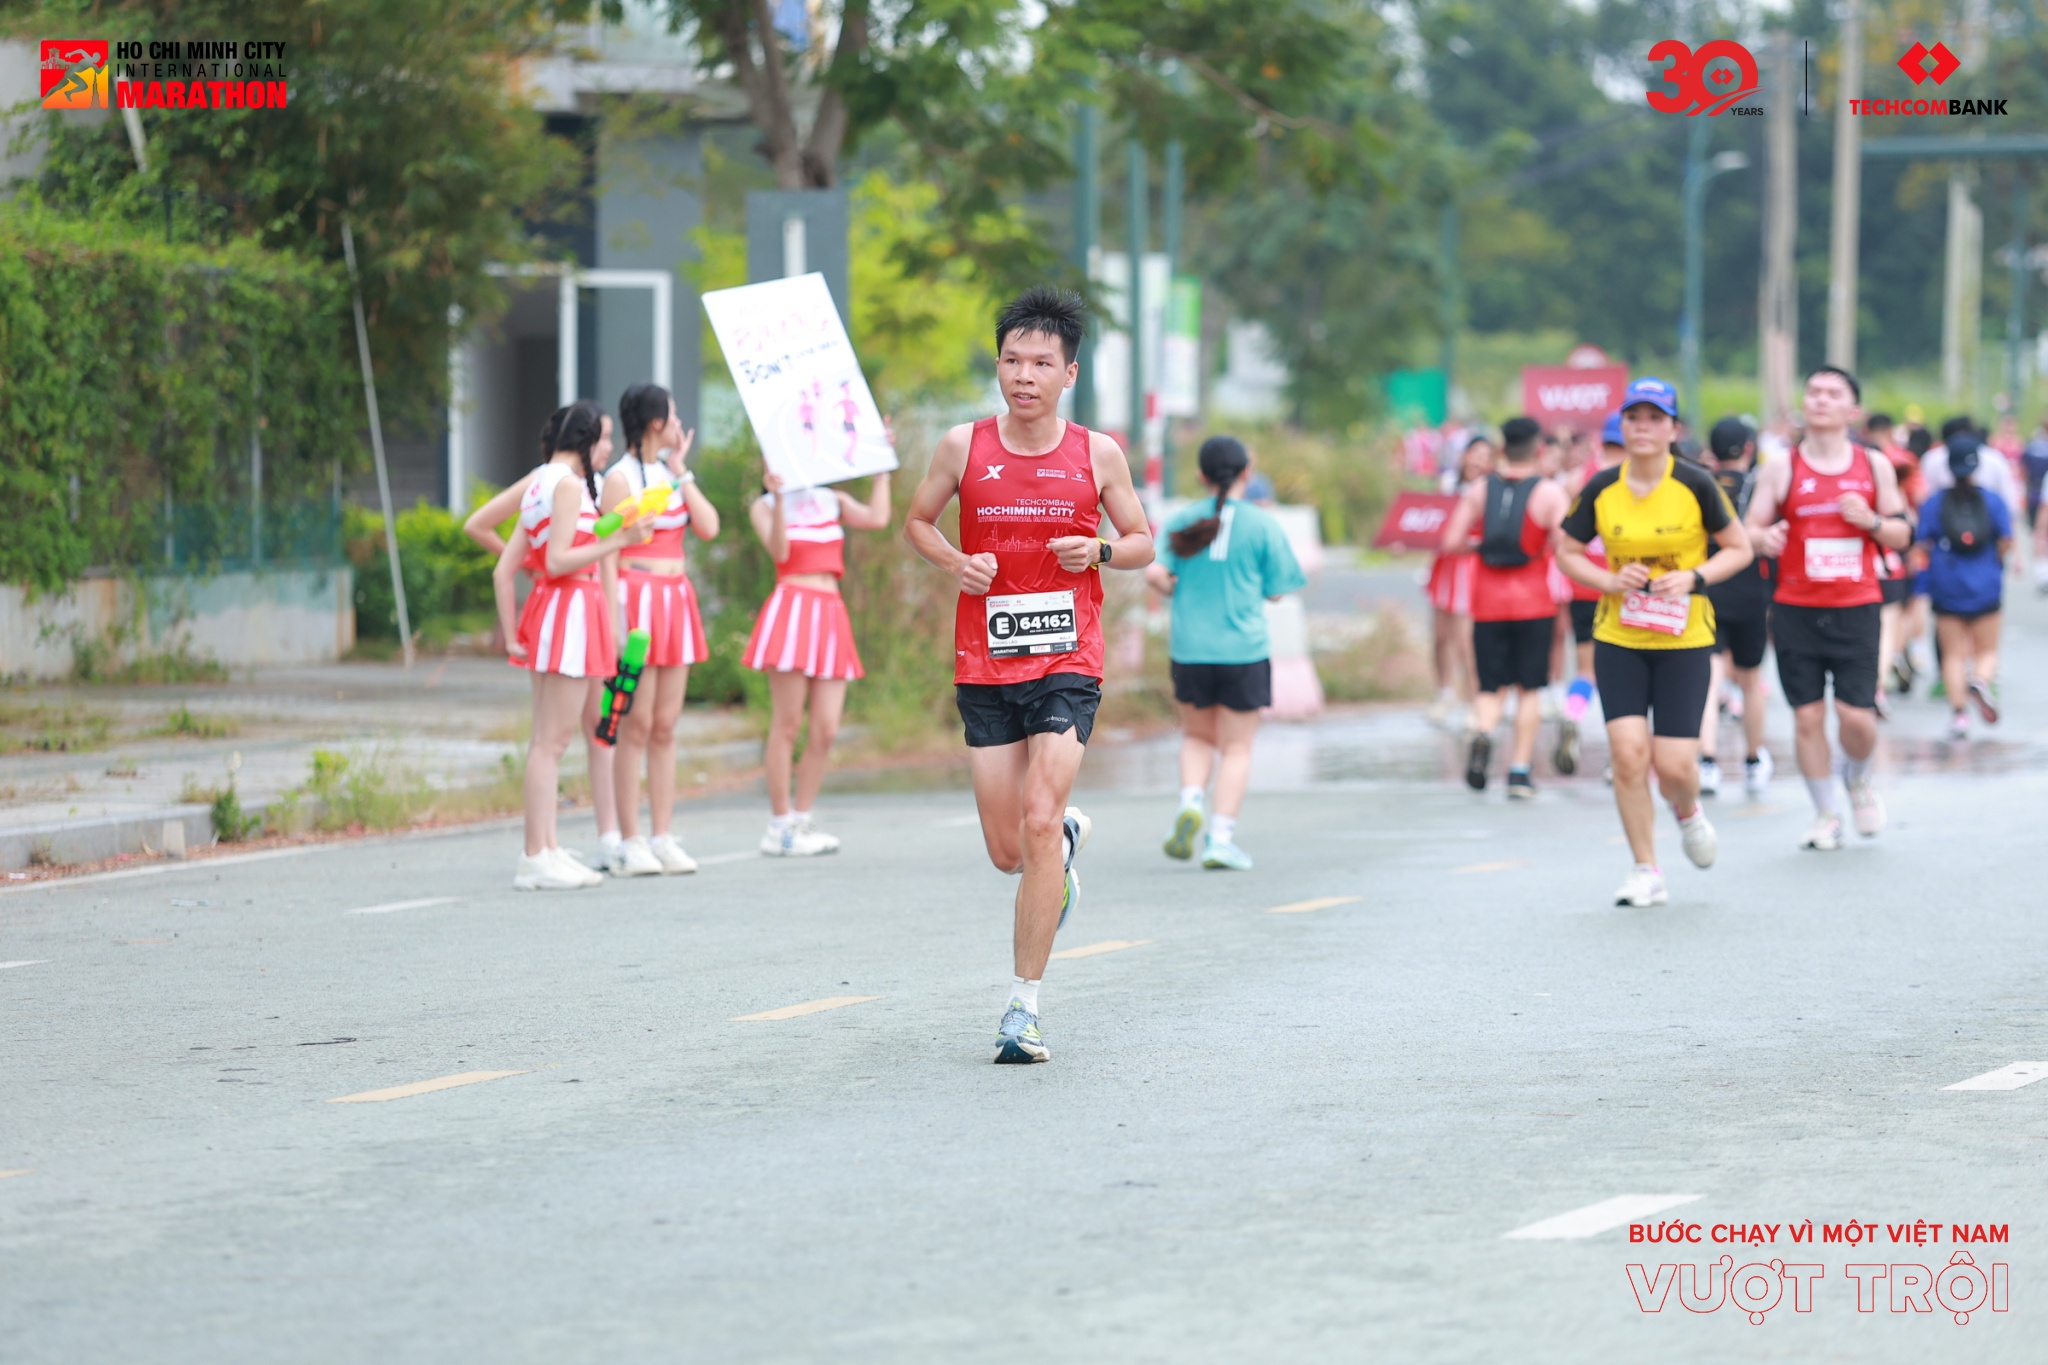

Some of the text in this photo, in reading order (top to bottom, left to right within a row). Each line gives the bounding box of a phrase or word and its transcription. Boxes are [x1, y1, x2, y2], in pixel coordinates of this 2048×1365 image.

[1015, 498, 1075, 508] TECHCOMBANK
[976, 506, 1075, 518] HOCHIMINH CITY
[996, 613, 1072, 635] E 64162
